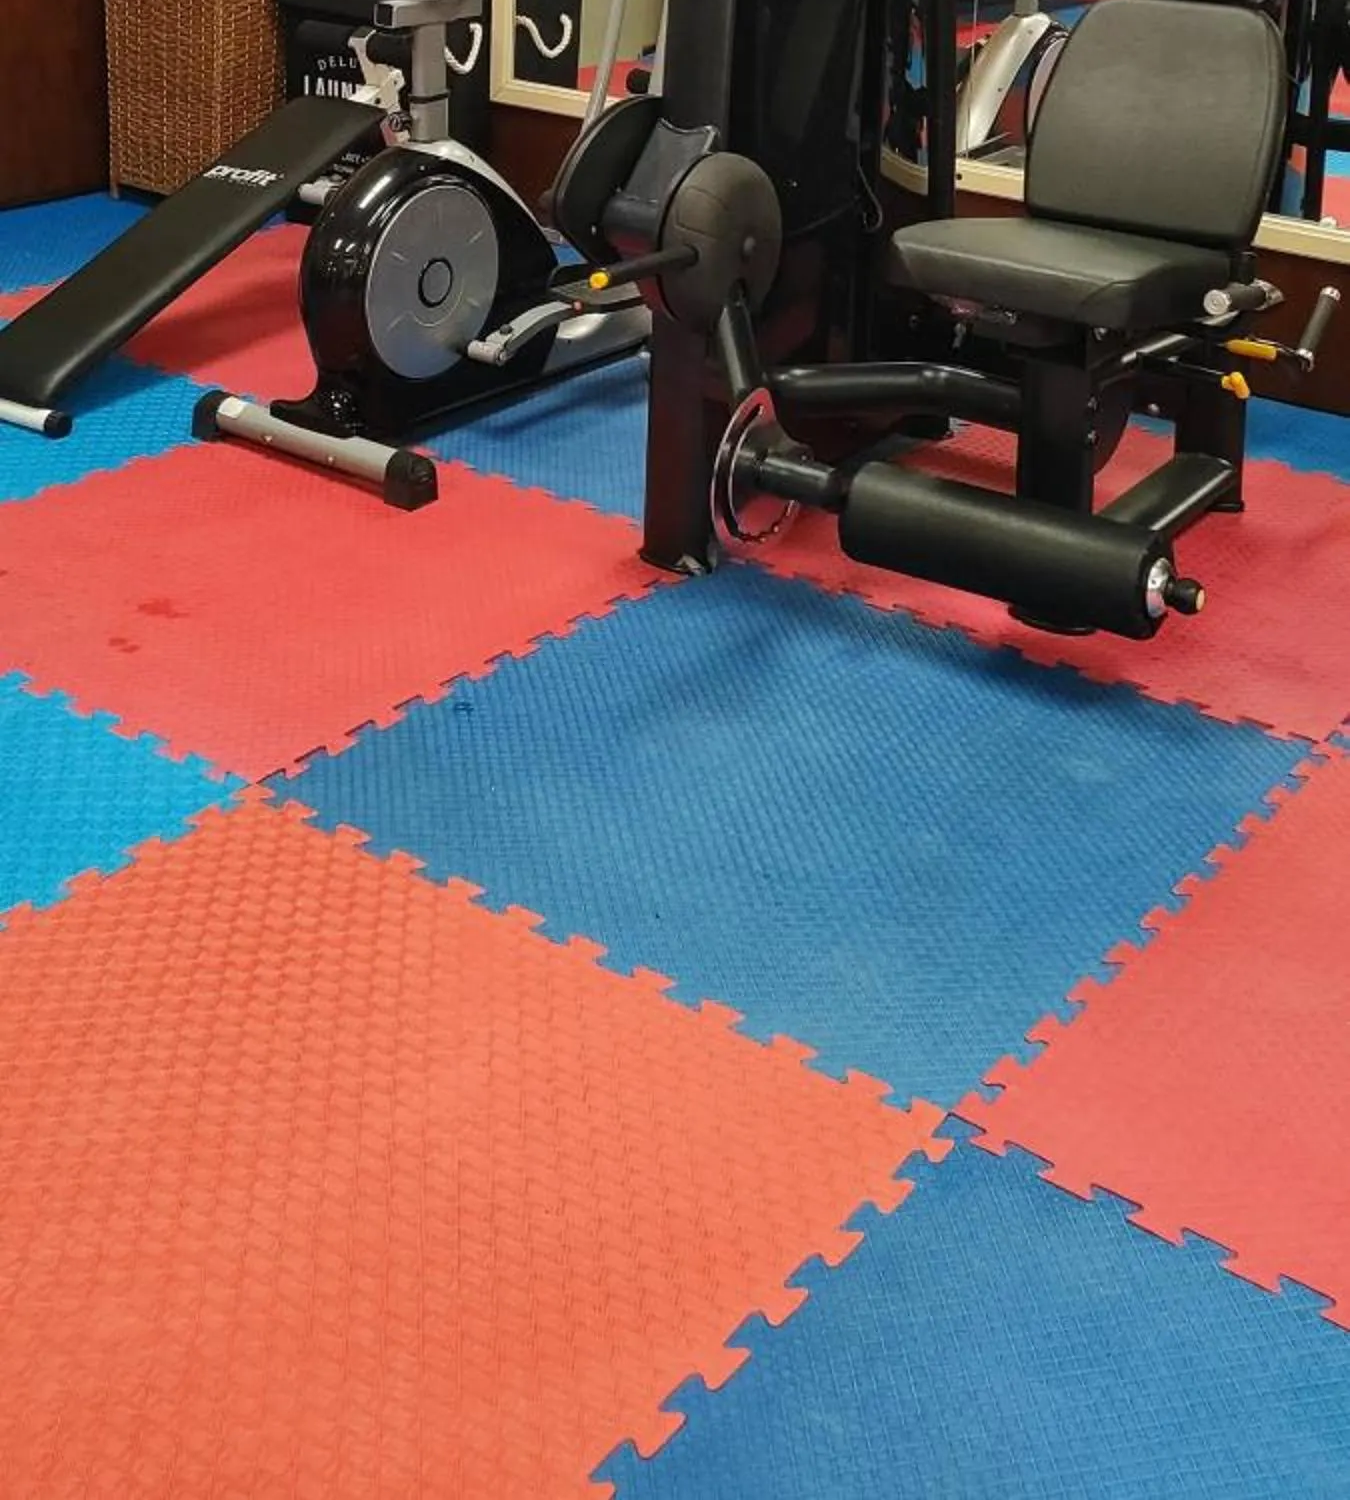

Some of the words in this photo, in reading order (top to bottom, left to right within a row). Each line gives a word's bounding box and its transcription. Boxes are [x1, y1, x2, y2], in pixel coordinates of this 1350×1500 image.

[317, 55, 357, 71] DELU
[304, 75, 353, 99] LAUN
[203, 165, 277, 187] profit
